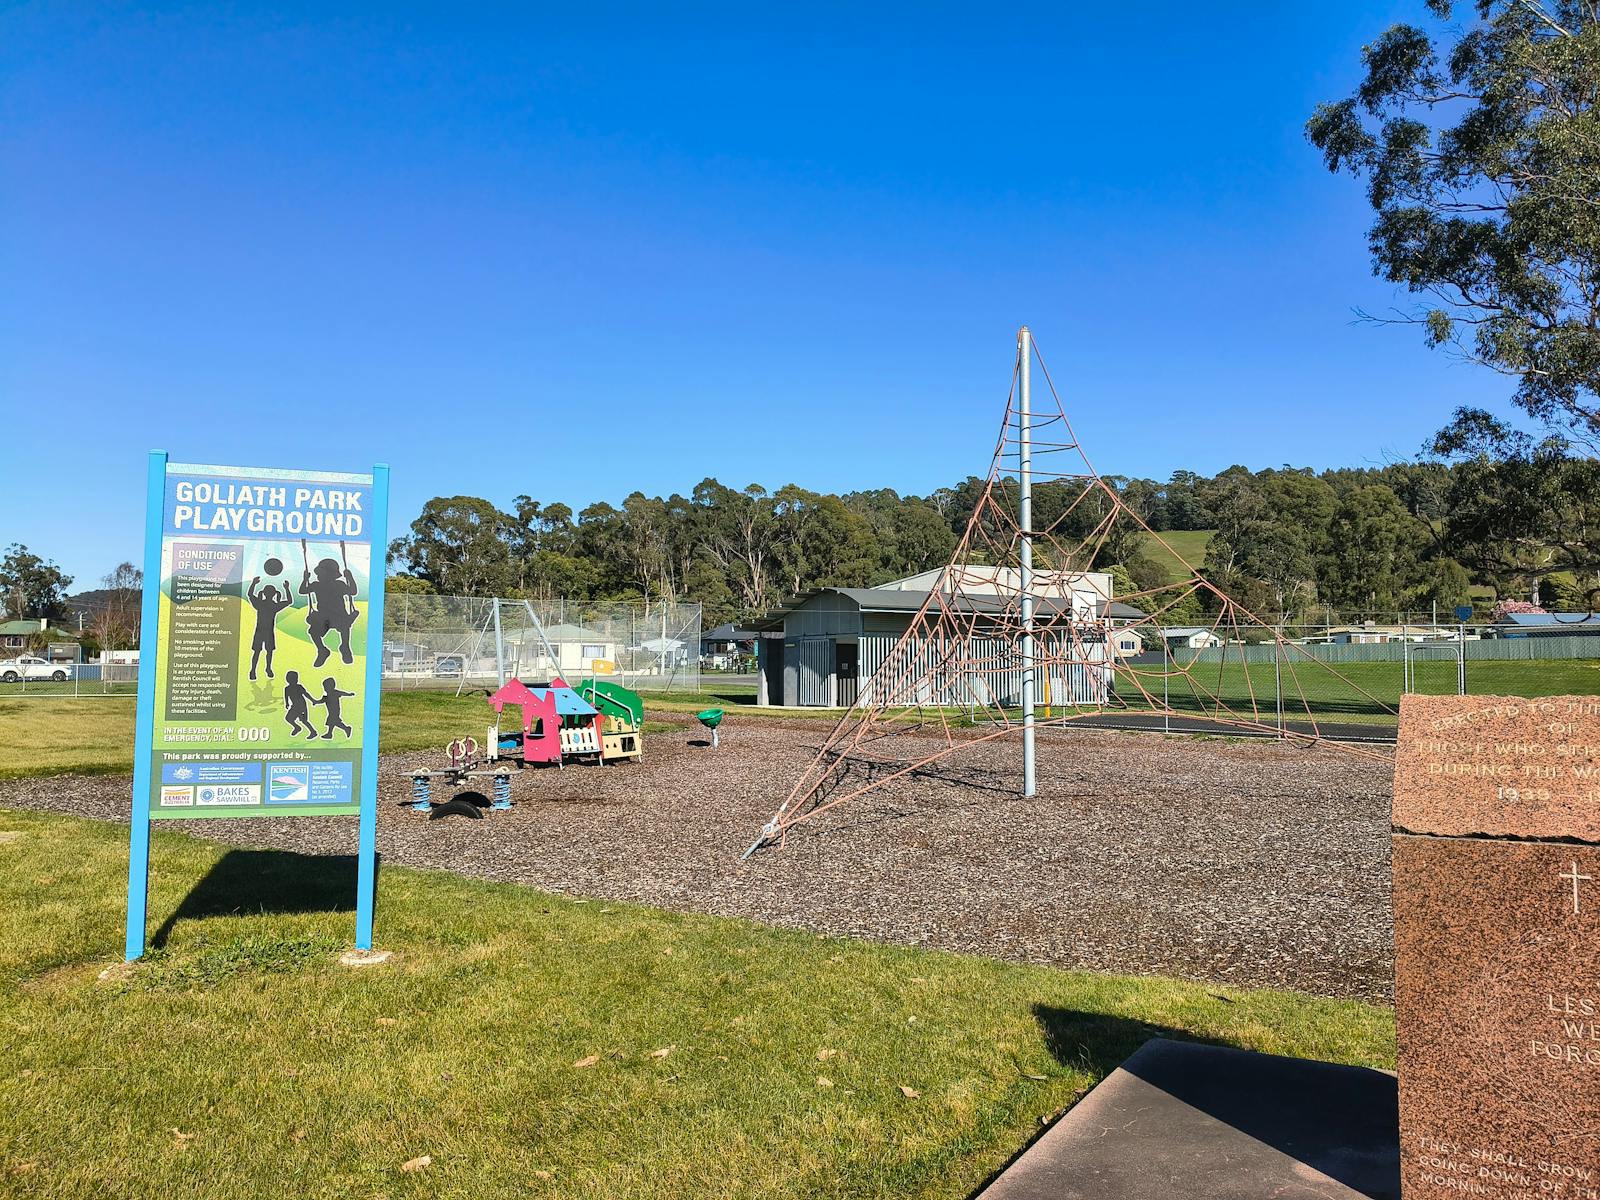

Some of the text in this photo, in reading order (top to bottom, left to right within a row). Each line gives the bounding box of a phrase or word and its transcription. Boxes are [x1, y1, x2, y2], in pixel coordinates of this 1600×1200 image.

[176, 482, 362, 510] GOLIATH PARK
[174, 506, 362, 536] PLAYGROUND
[178, 550, 236, 560] CONDITIONS
[178, 561, 212, 570] OF USE
[1432, 705, 1520, 731] ERECTED
[1527, 703, 1555, 714] TO
[238, 727, 270, 742] 000
[1550, 722, 1576, 734] OF
[1417, 742, 1485, 754] THOSE
[1495, 742, 1545, 755] WHO
[222, 752, 251, 760] proudly
[254, 752, 293, 760] supported
[1430, 764, 1510, 777] DURING
[1523, 766, 1563, 778] THE
[218, 788, 250, 796] BAKES
[1499, 787, 1550, 802] 1939
[1471, 1148, 1527, 1168] SHALL
[1538, 1160, 1592, 1182] GROW
[1420, 1156, 1469, 1174] GOING
[1480, 1166, 1530, 1186] DOWN
[1540, 1180, 1563, 1193] OF
